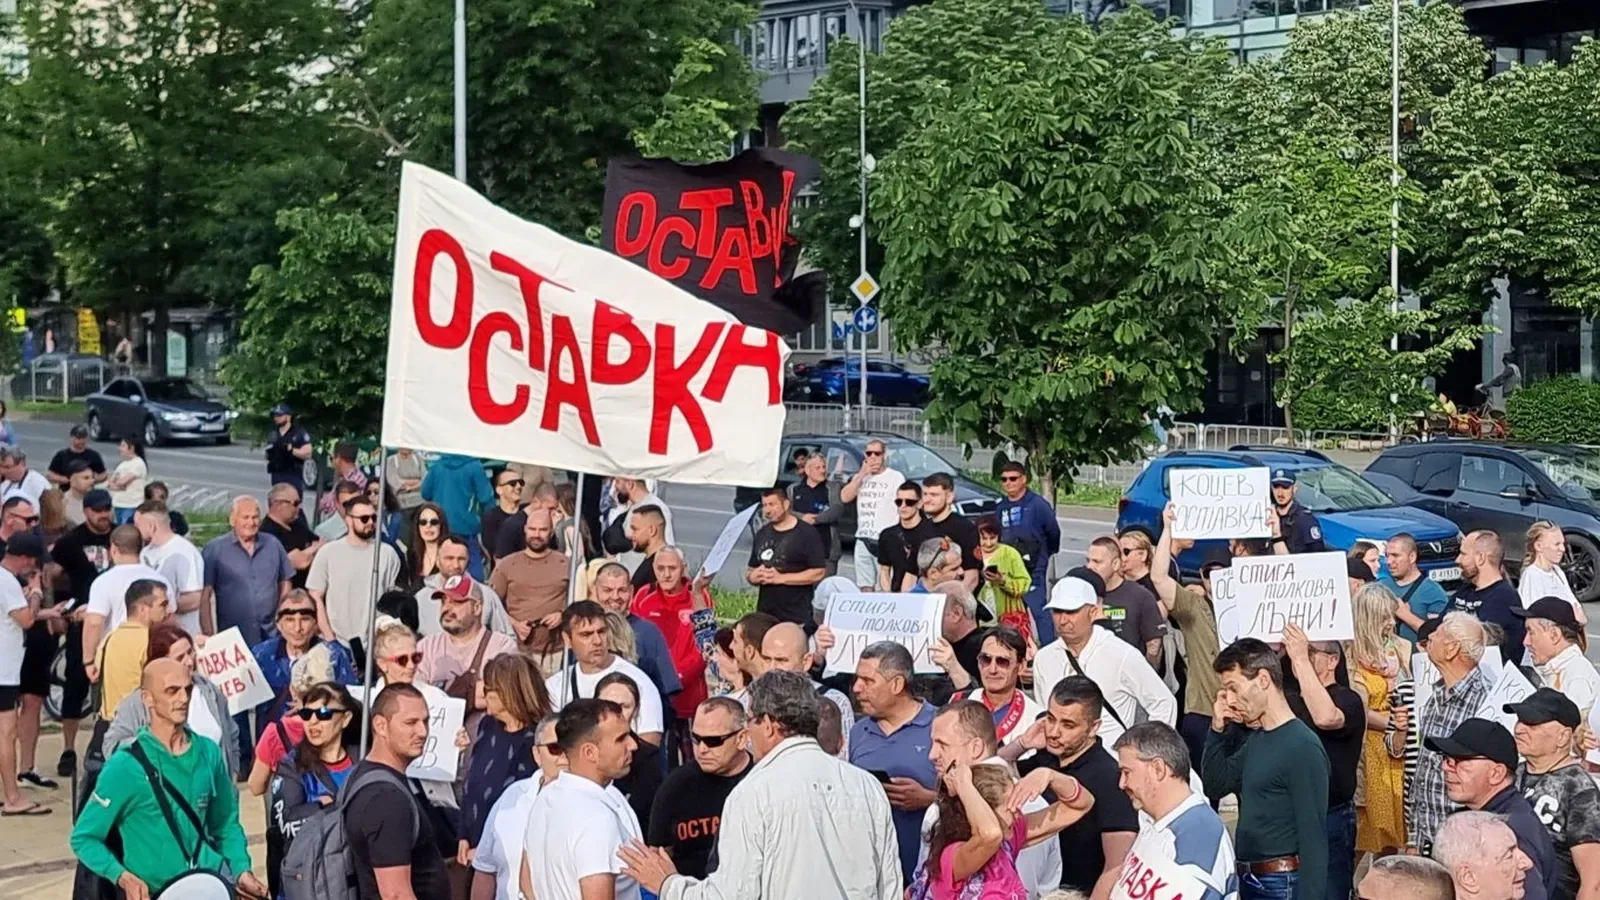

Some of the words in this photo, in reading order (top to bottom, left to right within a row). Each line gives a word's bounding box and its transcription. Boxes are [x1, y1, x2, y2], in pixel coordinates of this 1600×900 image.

[413, 228, 782, 455] ОСТАВКА
[1176, 472, 1255, 502] КОЦЕВ
[1239, 562, 1296, 585] СТИГА
[1264, 578, 1336, 600] ТОЛКОВА
[838, 599, 898, 614] СТИГА
[1246, 598, 1338, 635] ЛЪЖИ!
[861, 618, 930, 635] ТОЛКОВА
